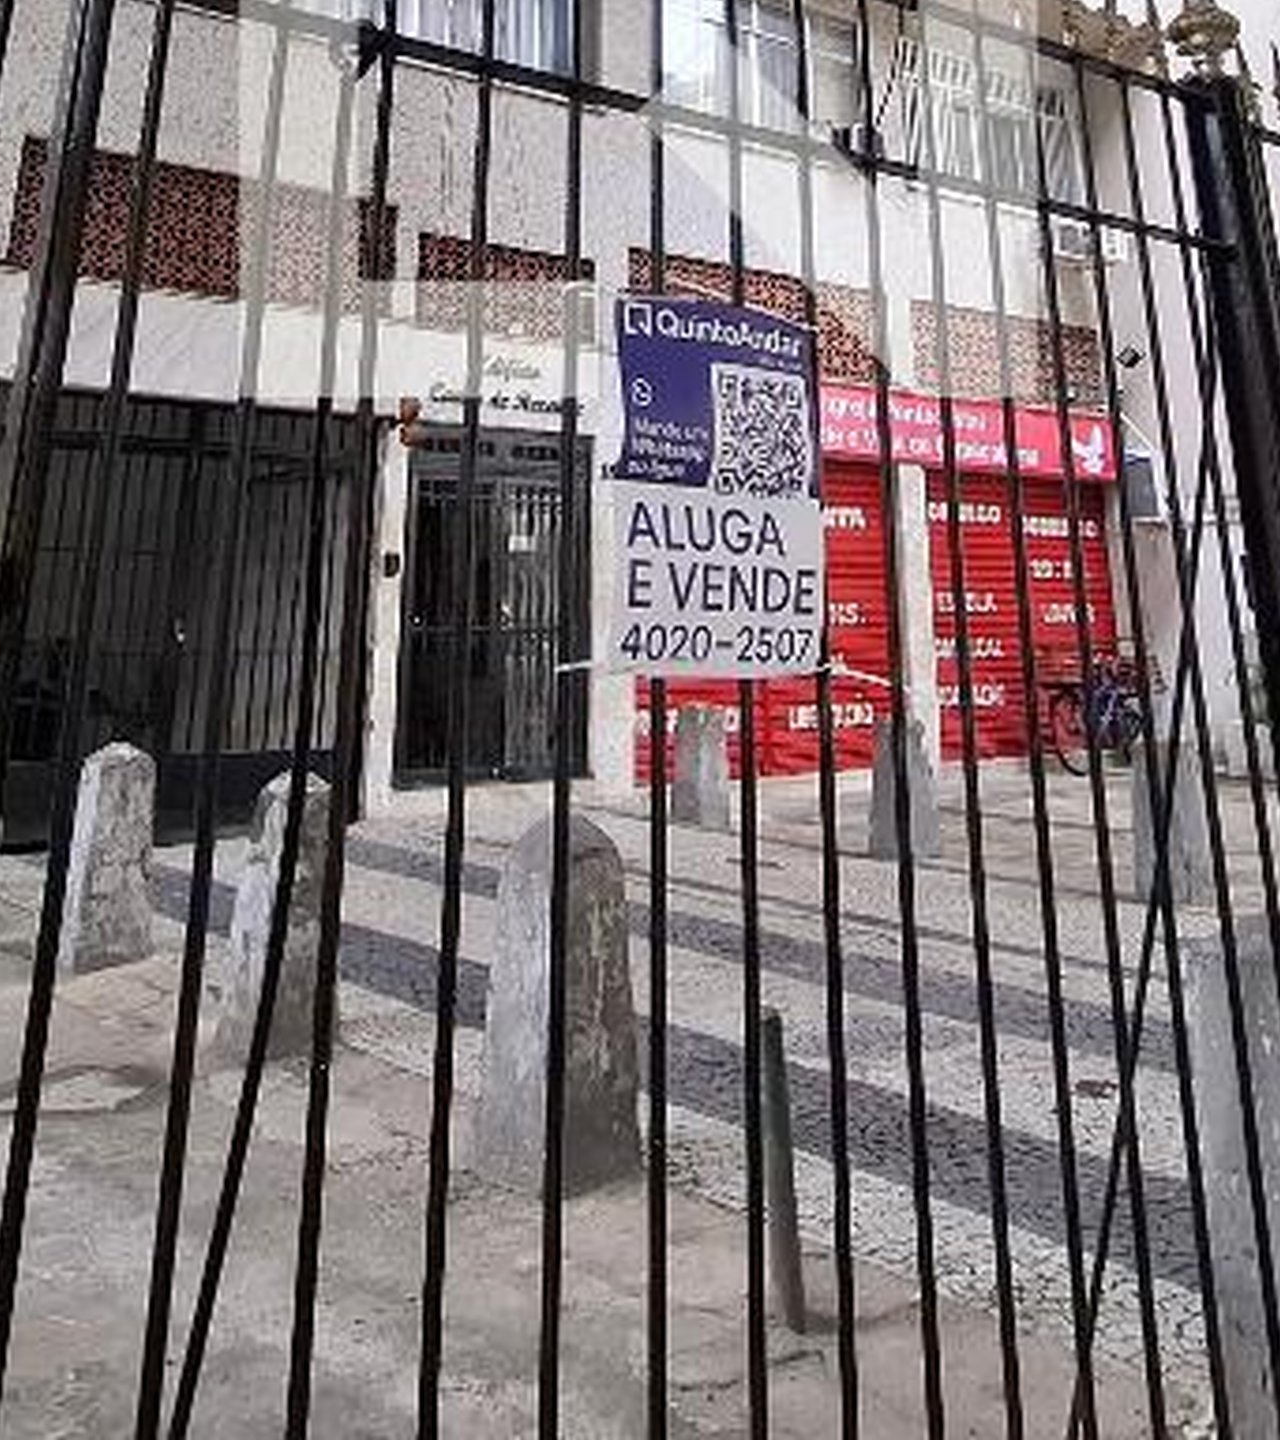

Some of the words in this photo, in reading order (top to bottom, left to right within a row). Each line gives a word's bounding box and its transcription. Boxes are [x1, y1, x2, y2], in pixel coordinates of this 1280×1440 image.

[656, 308, 802, 357] QuintoAndar
[628, 501, 786, 556] ALUGA
[628, 560, 652, 608] E
[668, 562, 816, 615] VENDE
[620, 624, 814, 663] 4020-2507
